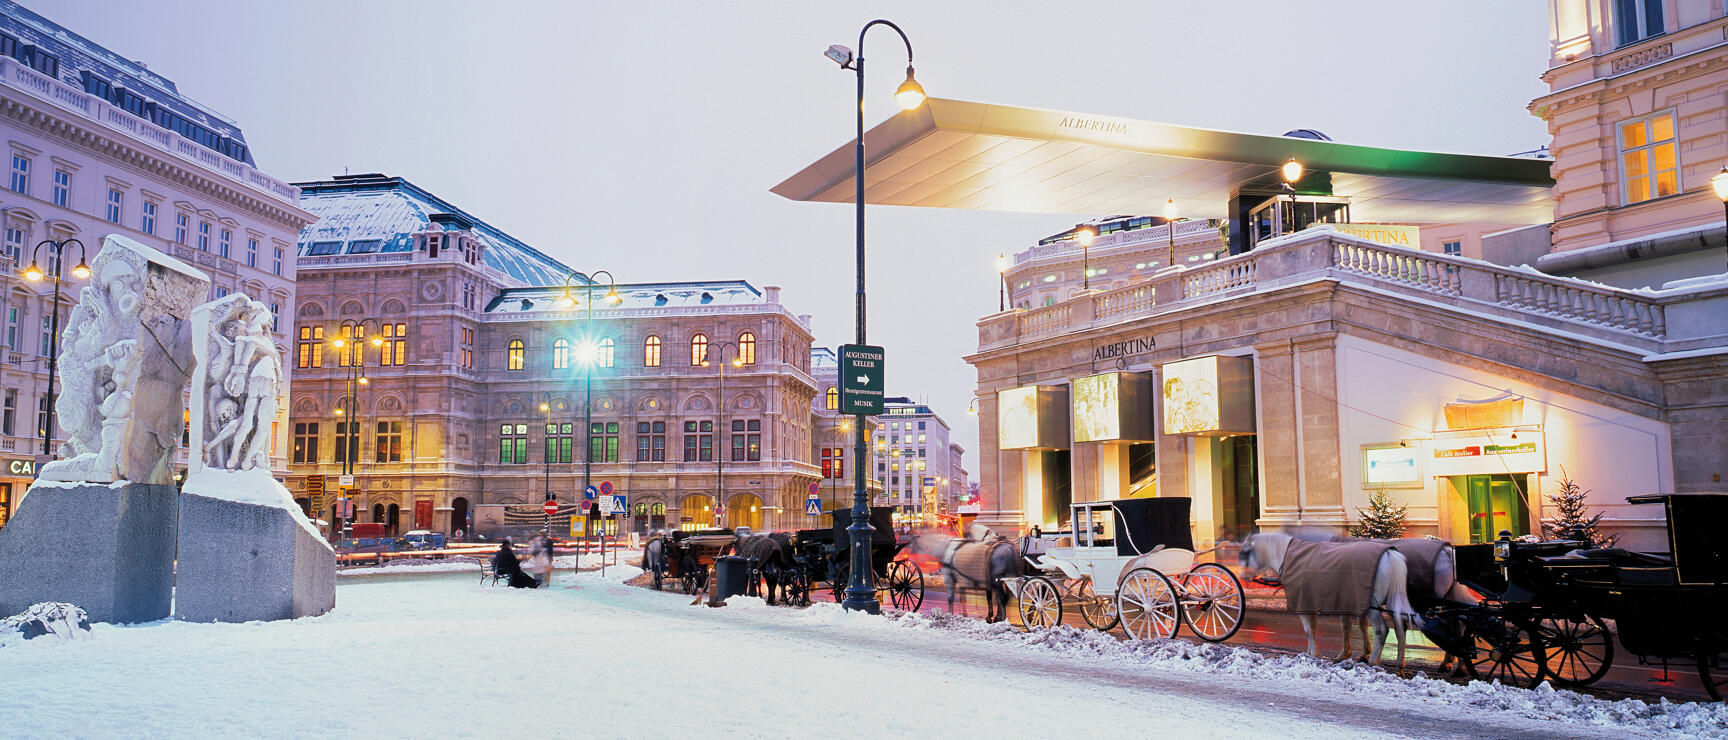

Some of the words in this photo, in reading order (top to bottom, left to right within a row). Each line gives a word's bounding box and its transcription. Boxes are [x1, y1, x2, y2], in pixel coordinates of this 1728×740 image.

[1060, 117, 1127, 133] ALBERTINA
[1094, 336, 1156, 360] ALBERTINA
[845, 351, 883, 361] AUGUSTINER
[852, 360, 875, 368] KELLER
